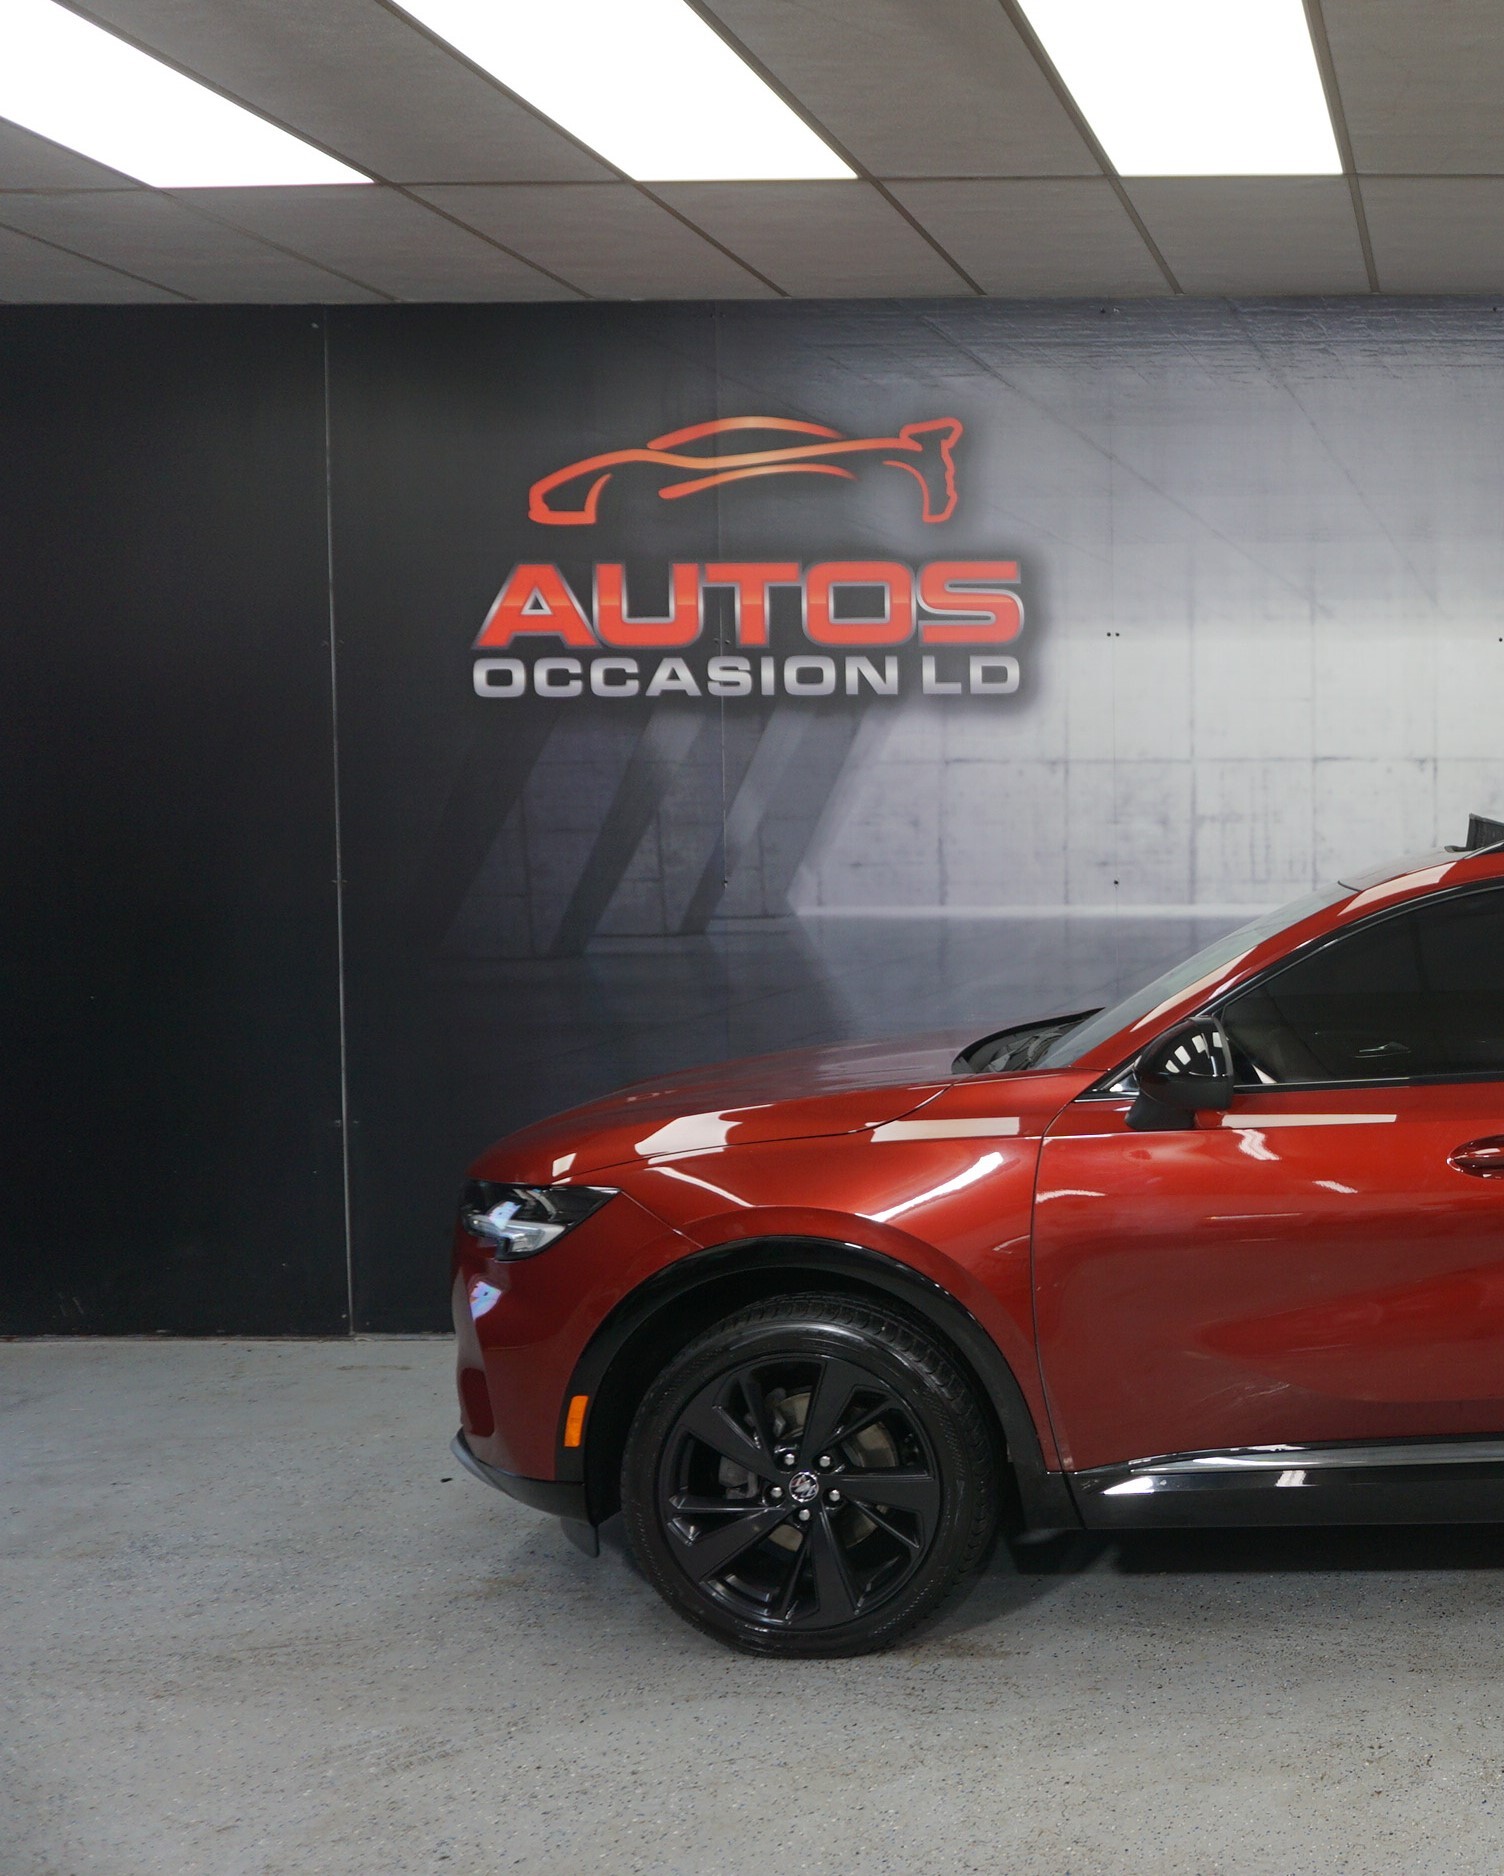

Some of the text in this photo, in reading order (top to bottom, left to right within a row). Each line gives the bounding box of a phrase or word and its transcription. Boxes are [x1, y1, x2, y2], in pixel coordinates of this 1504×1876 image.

[472, 561, 1024, 648] AUTOS
[472, 655, 1021, 698] OCCASION LD
